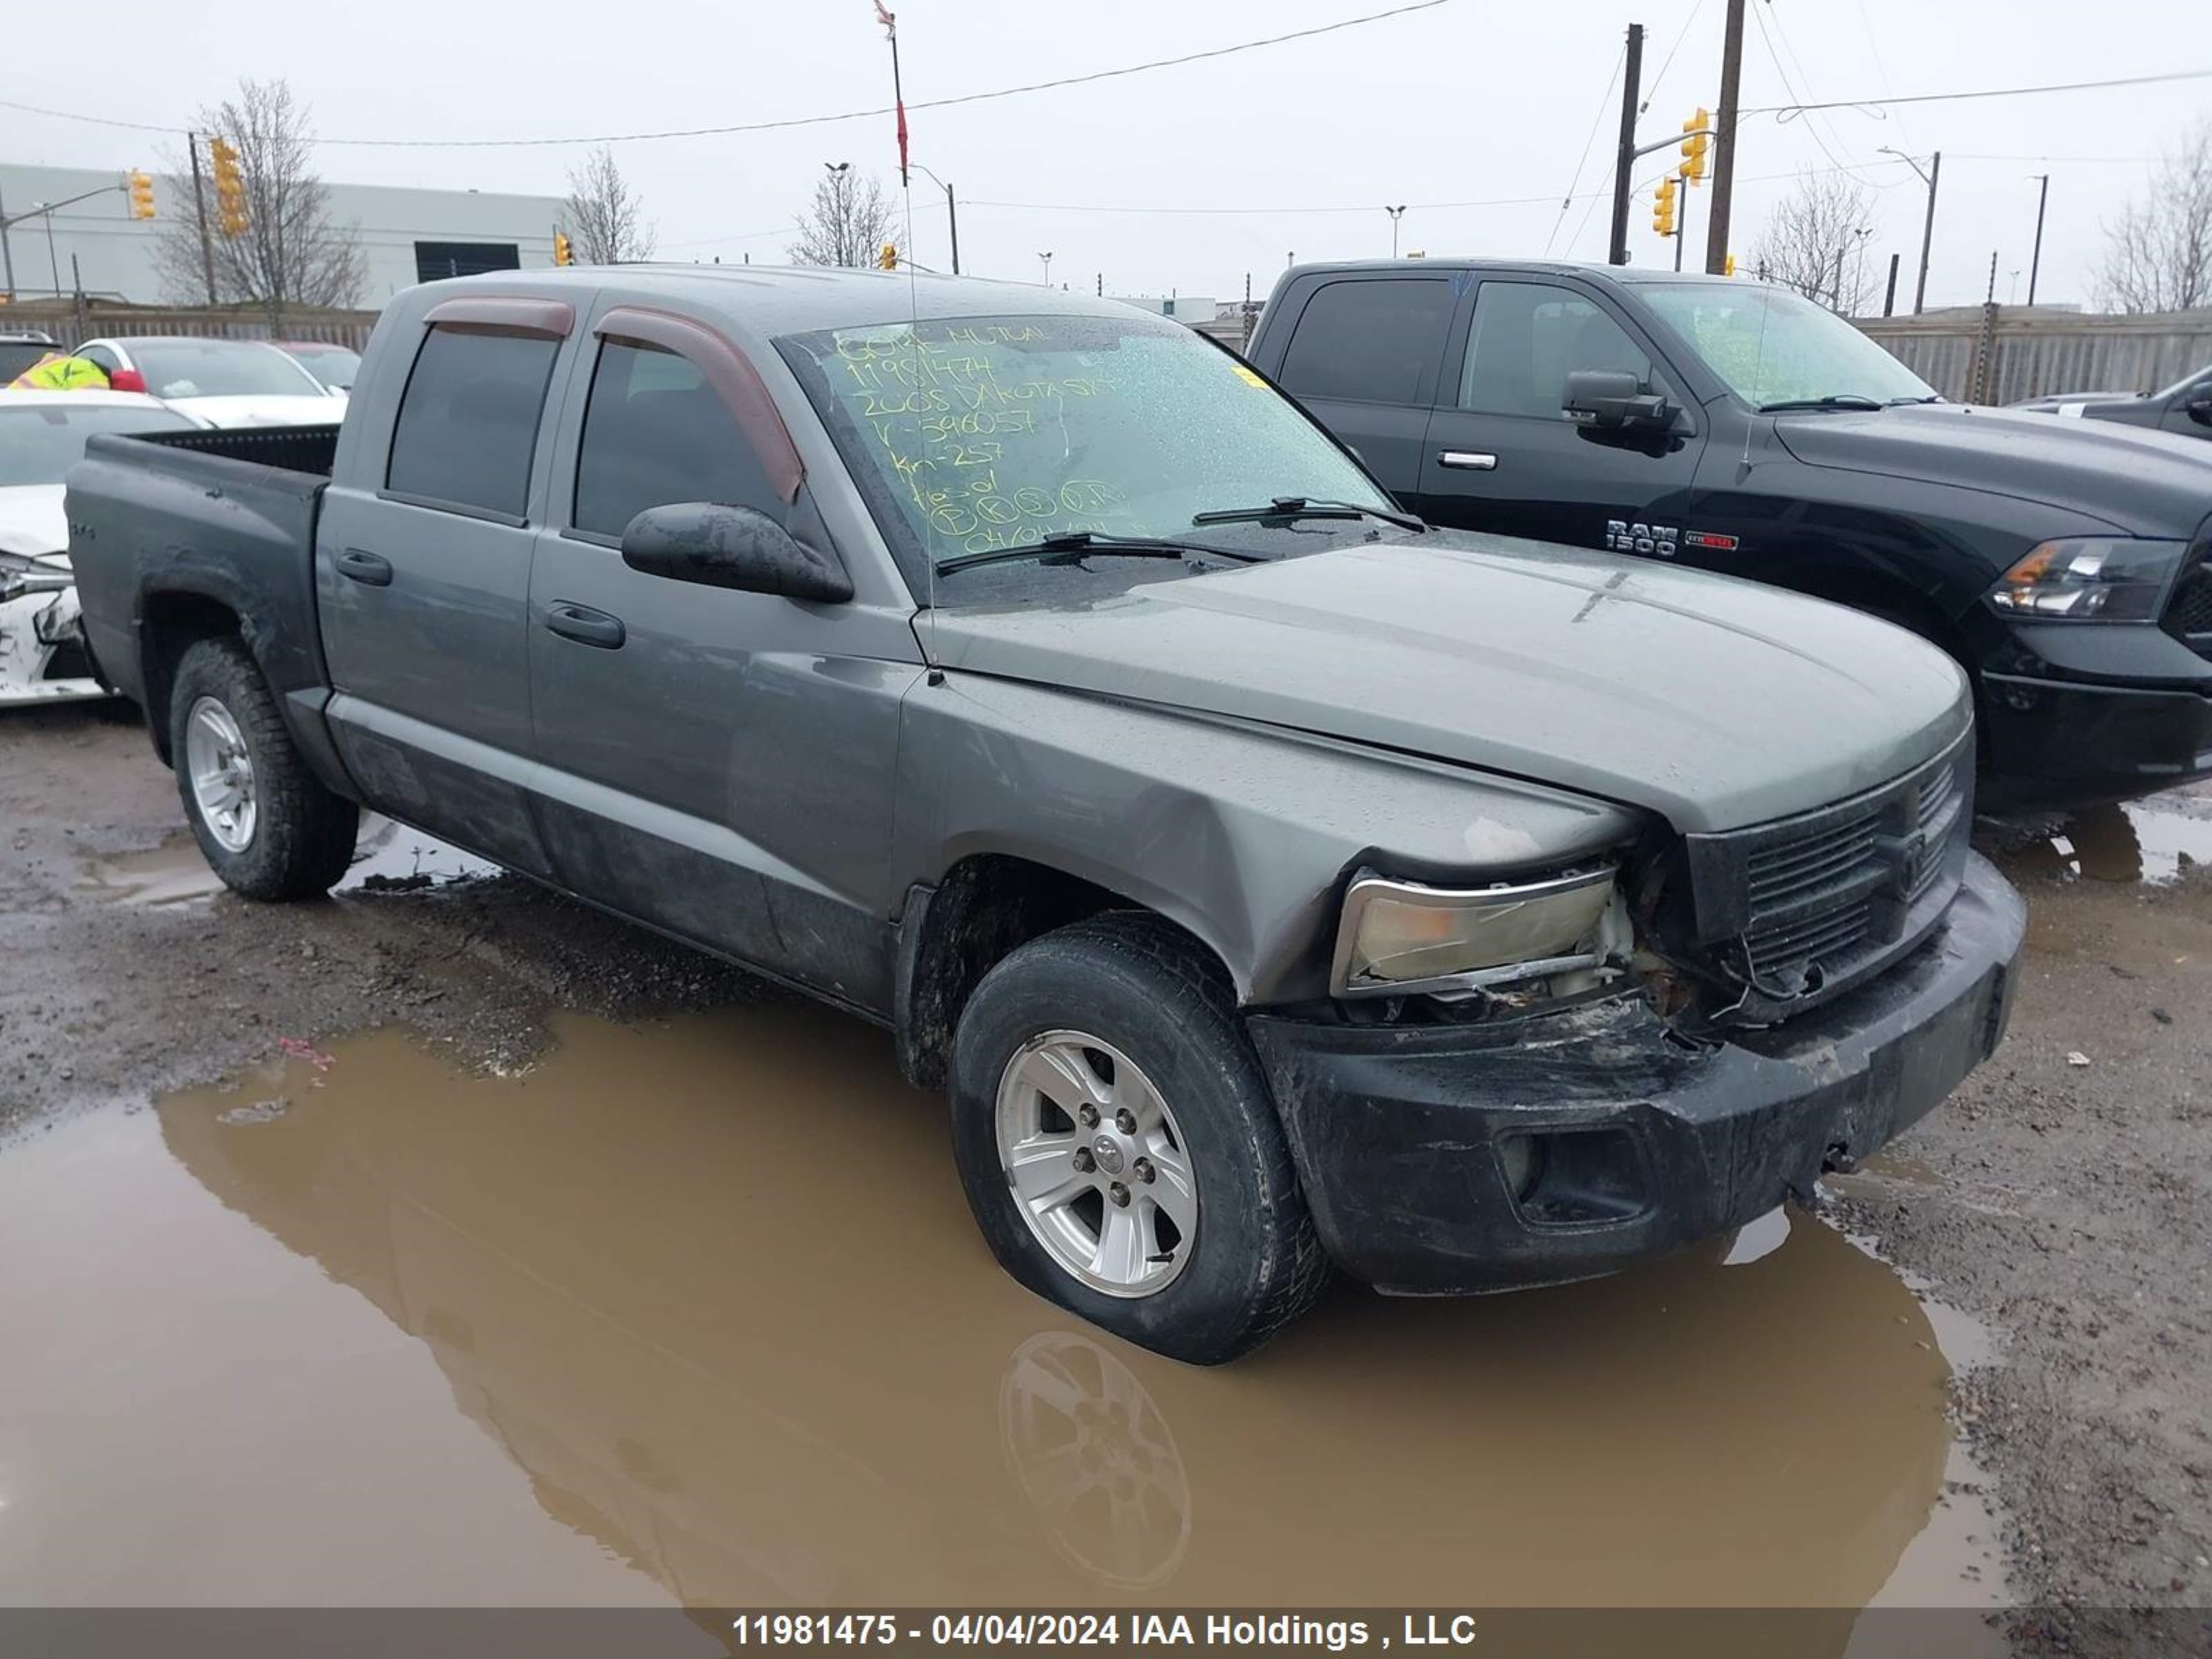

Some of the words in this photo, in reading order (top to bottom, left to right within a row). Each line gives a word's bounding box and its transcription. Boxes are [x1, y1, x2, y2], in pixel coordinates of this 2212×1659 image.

[847, 355, 996, 388] 11981474
[864, 388, 950, 415] 2008
[1606, 520, 1679, 542] RAM
[1606, 534, 1676, 556] 1500
